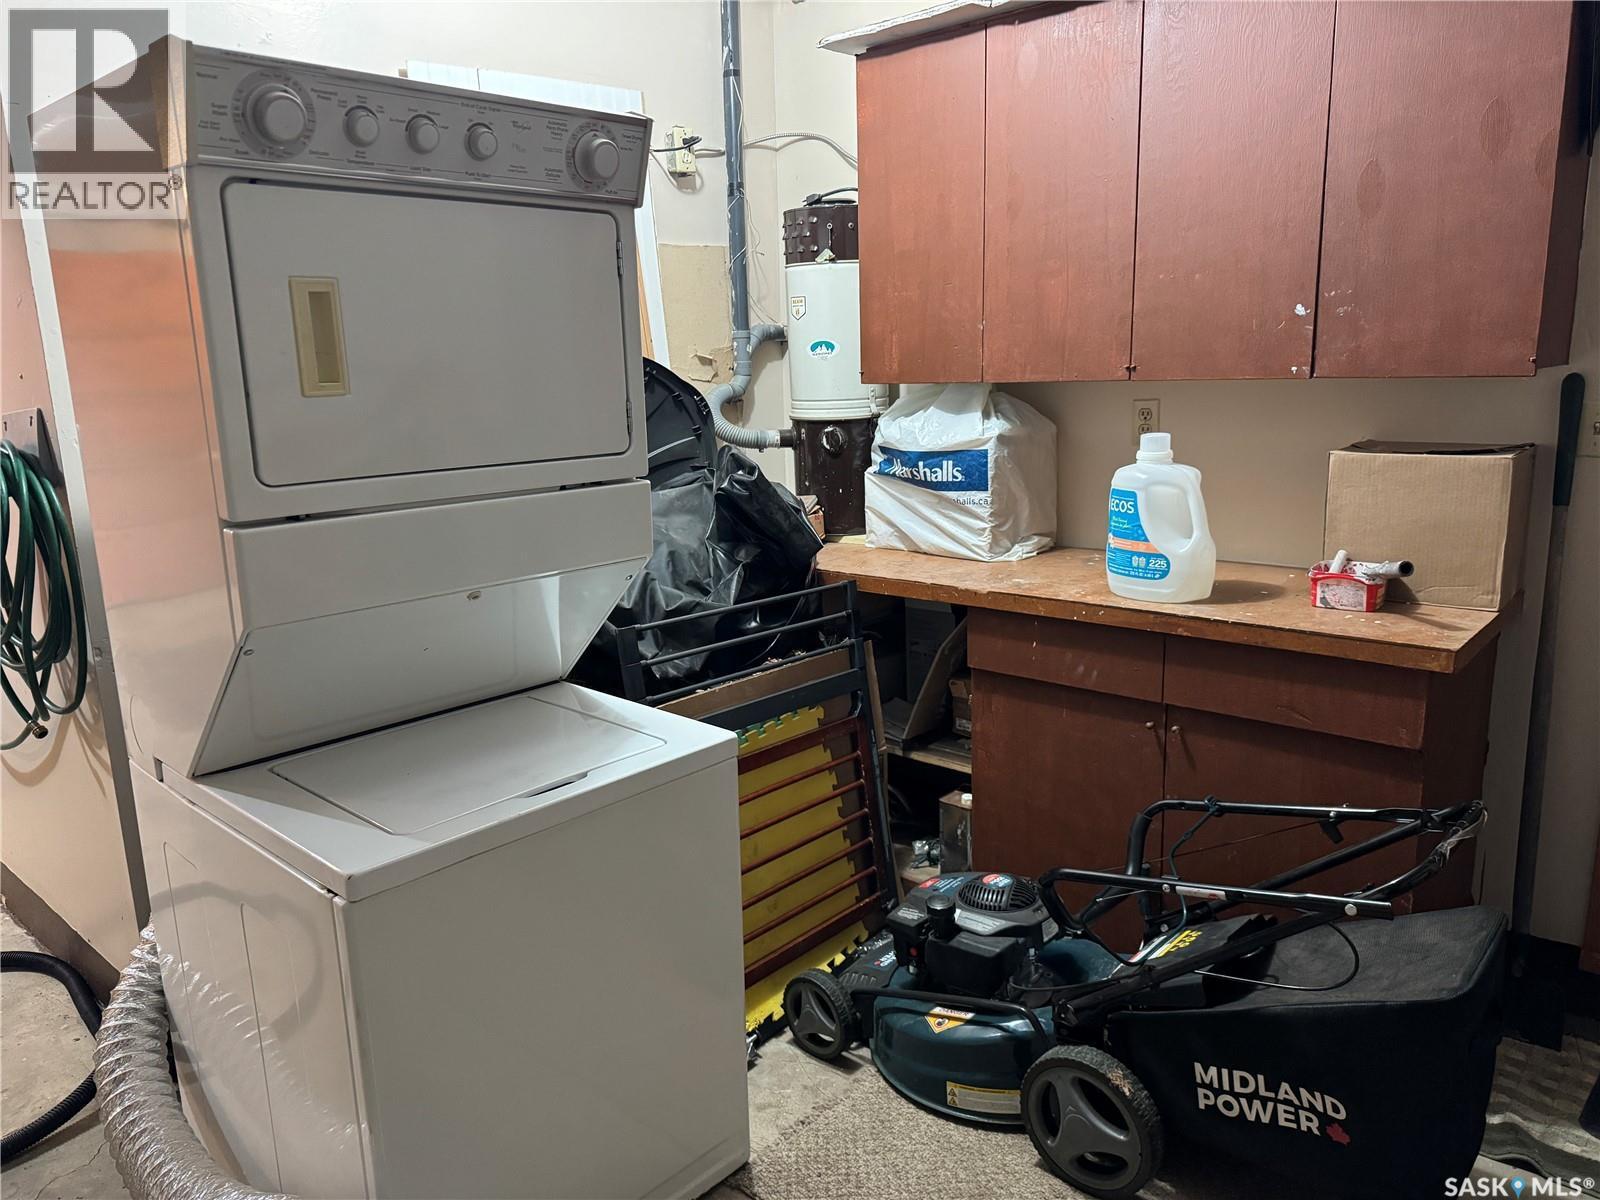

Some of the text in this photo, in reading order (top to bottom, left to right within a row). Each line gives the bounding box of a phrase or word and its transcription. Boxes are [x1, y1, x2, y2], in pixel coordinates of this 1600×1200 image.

[885, 457, 963, 482] Marshalls
[1110, 498, 1135, 514] ECOS
[1149, 559, 1168, 568] 225
[1193, 1061, 1348, 1121] MIDLAND
[1196, 1086, 1322, 1136] POWER
